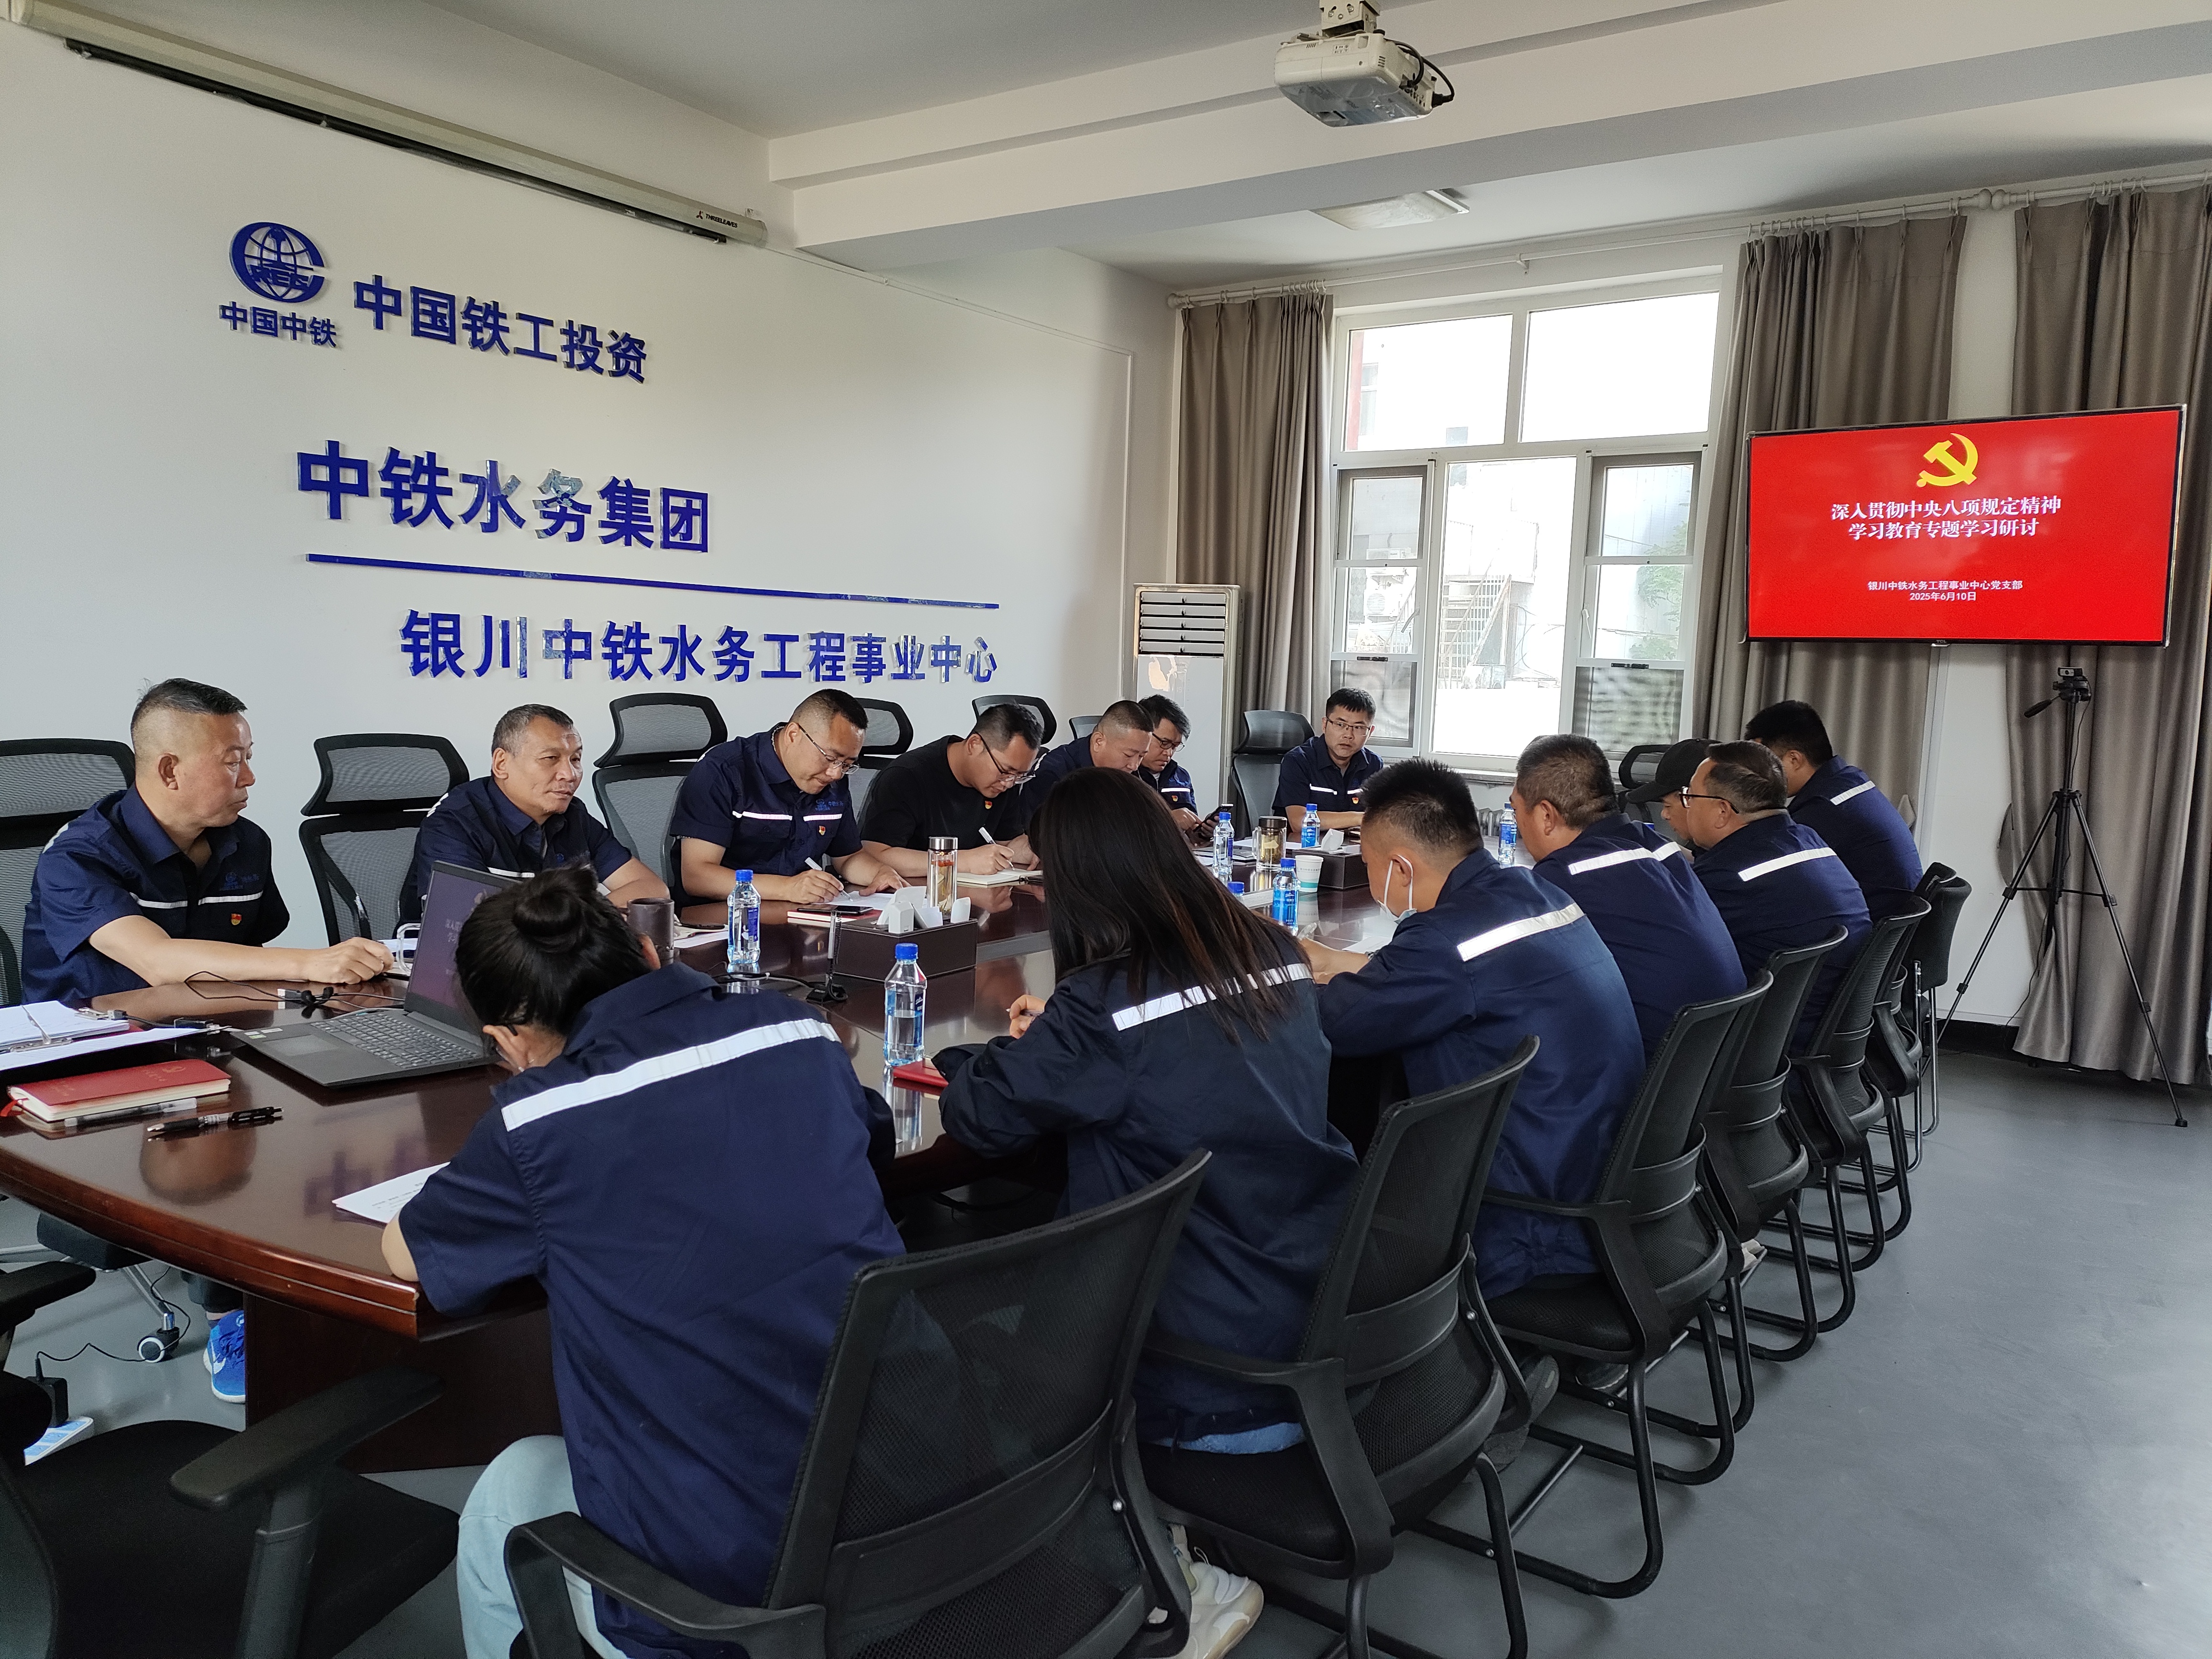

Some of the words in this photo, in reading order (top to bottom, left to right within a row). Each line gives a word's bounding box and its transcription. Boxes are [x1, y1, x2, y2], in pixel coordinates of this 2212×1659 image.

[706, 213, 738, 228] THREELEAVES
[220, 301, 336, 347] 中国中铁
[353, 275, 647, 383] 中国铁工投资
[297, 440, 708, 553] 中铁水务集团
[1831, 496, 2061, 520] 深入贯彻中央八项规定精神
[1848, 518, 2039, 540] 学习教育专题学习研讨
[1868, 580, 2023, 590] 银川中铁水务工程事业中心党支部
[1910, 591, 1976, 601] 2025年6月10日
[399, 609, 997, 683] 银川中铁水务工程事业中心
